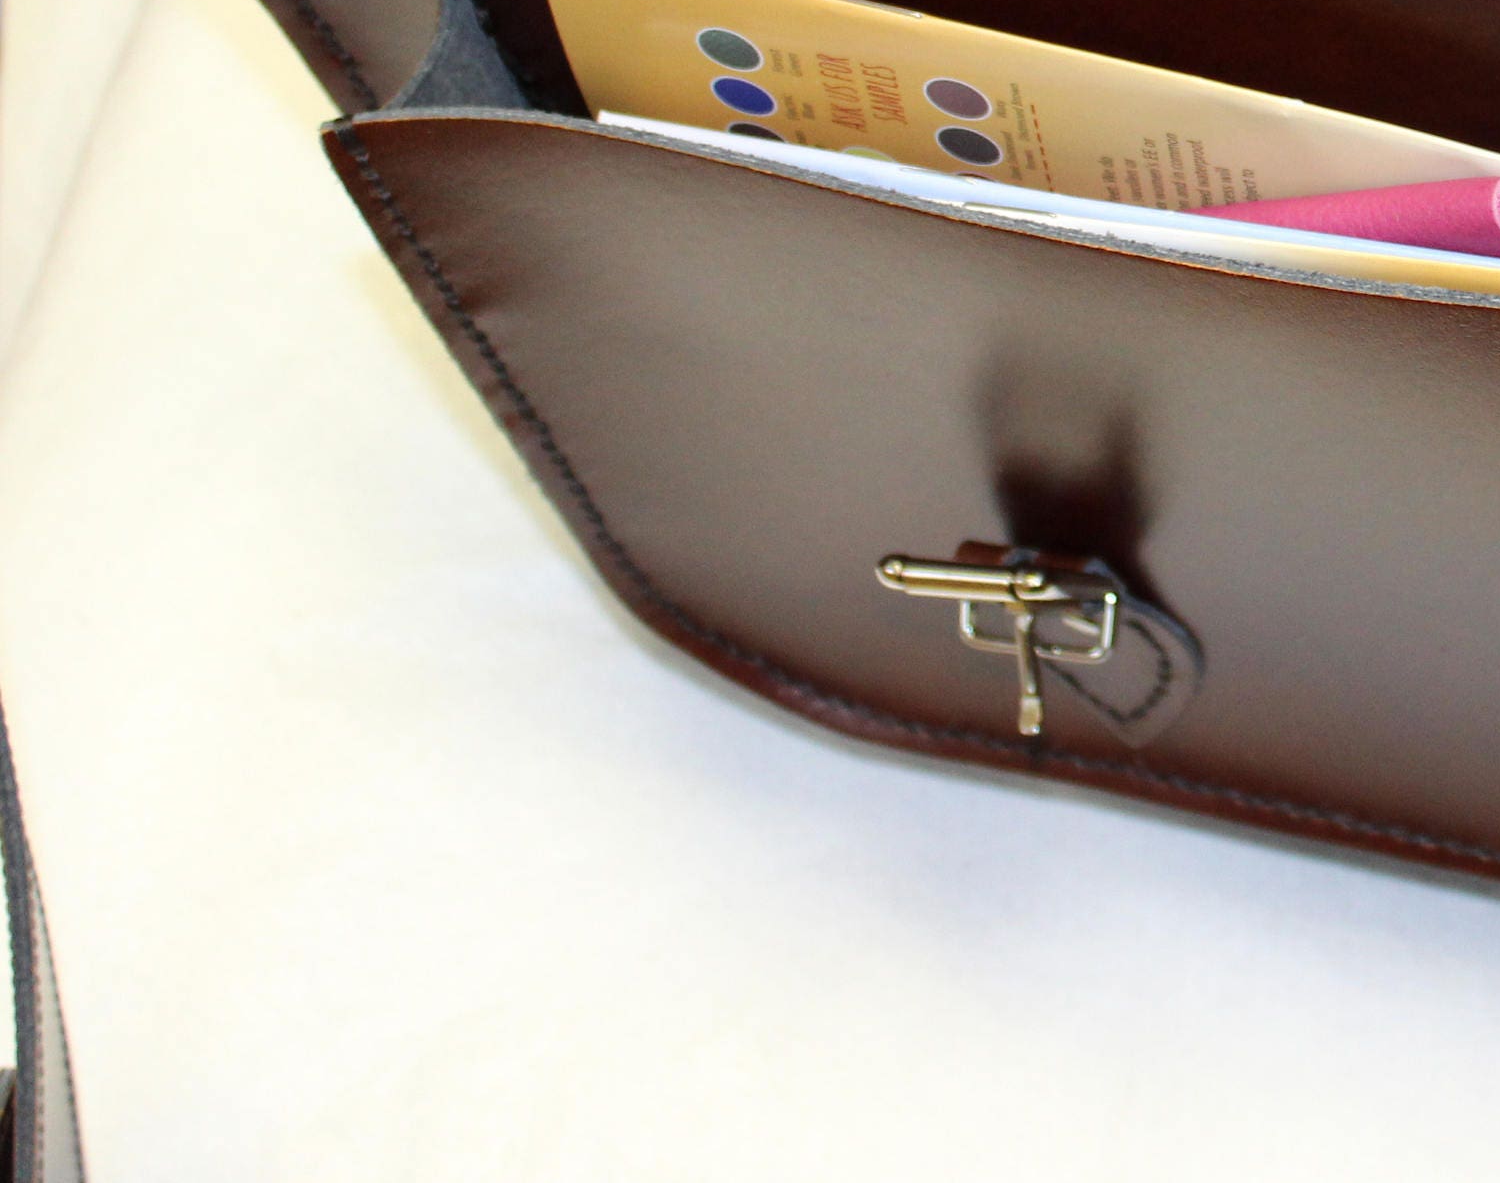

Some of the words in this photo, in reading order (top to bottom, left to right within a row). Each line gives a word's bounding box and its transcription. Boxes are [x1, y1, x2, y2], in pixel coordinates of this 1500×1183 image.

[816, 52, 853, 83] FOR
[822, 81, 860, 104] US
[860, 61, 909, 126] SAMPLES
[830, 101, 868, 134] ASK
[1166, 132, 1184, 170] common
